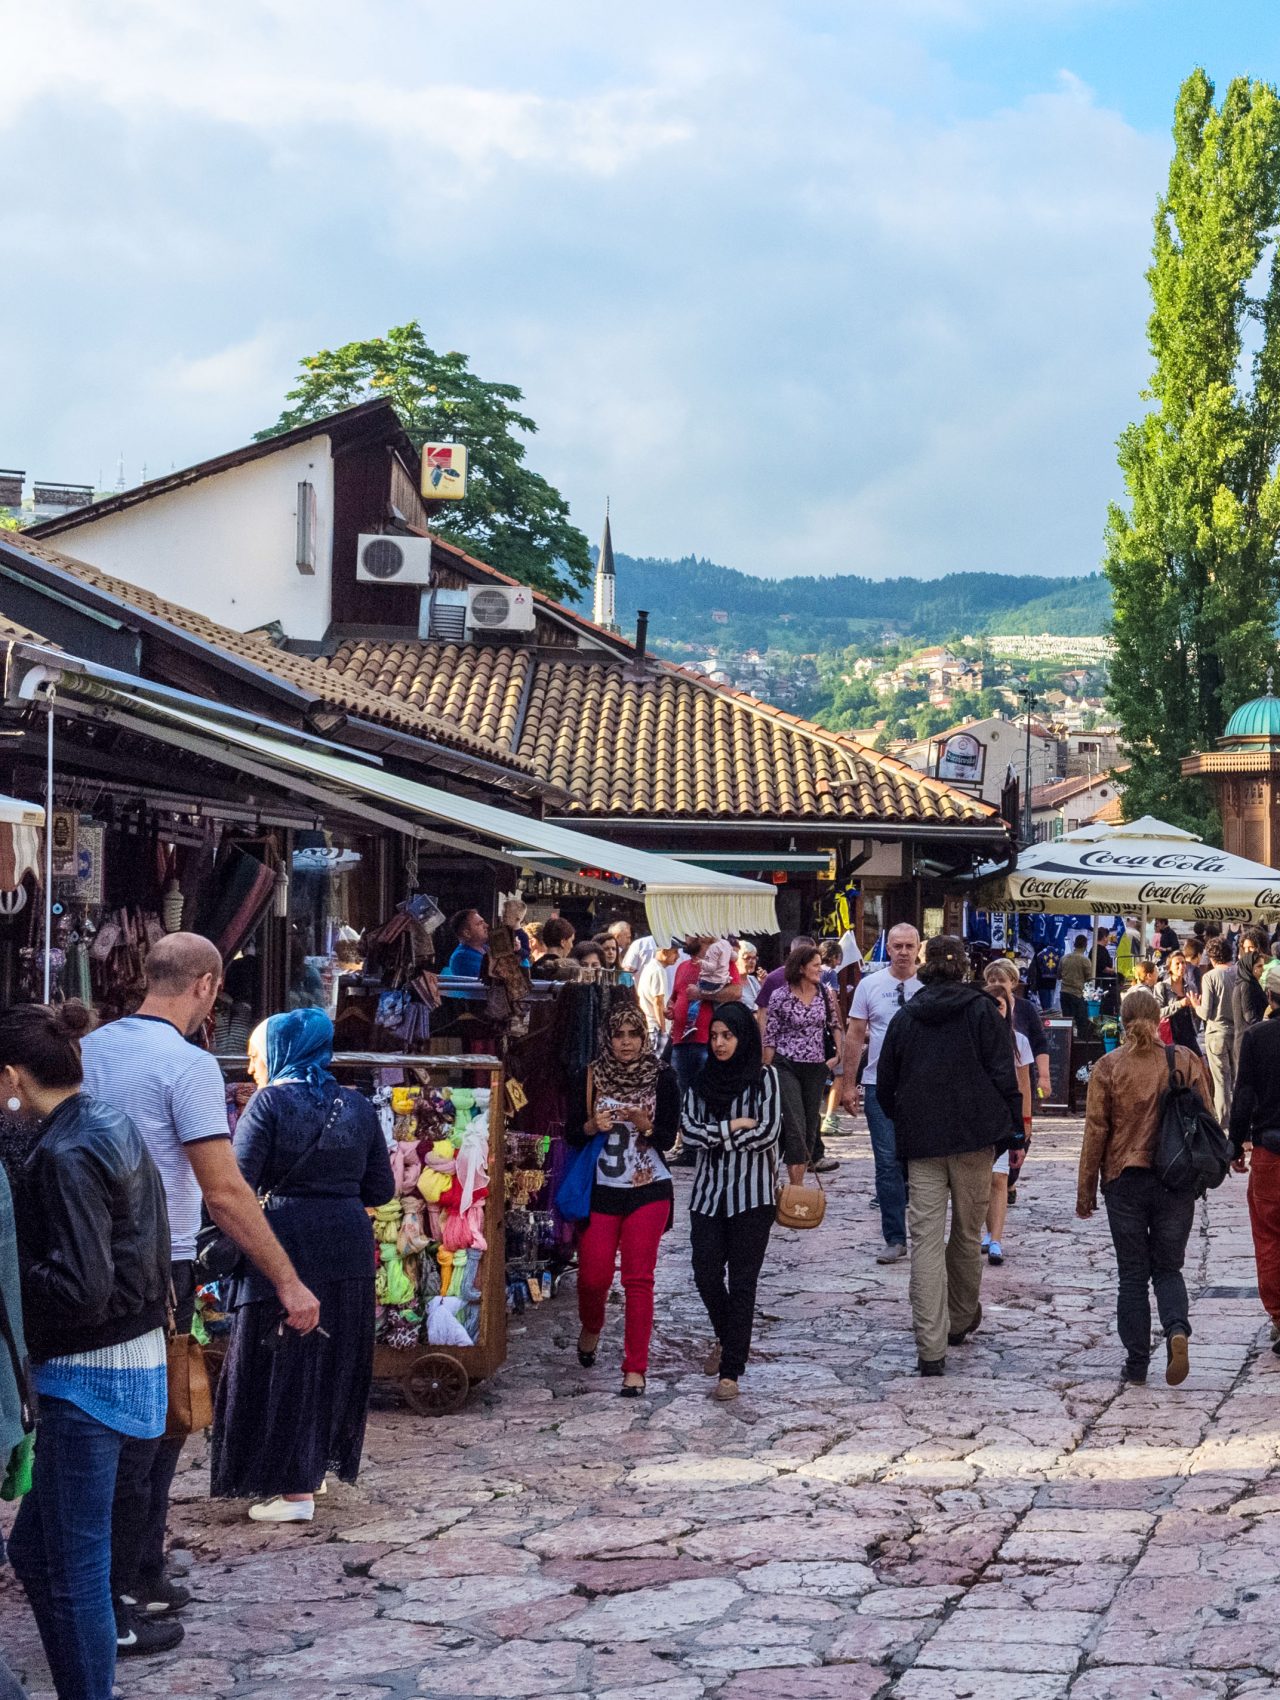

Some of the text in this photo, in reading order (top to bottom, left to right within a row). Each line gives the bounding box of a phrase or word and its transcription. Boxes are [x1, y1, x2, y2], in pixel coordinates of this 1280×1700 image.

[1079, 850, 1226, 873] Coca-Cola
[1019, 877, 1091, 899] Coca-Cola
[1138, 881, 1209, 905] Coca-Cola
[1055, 922, 1063, 939] 7
[598, 1123, 630, 1178] 9
